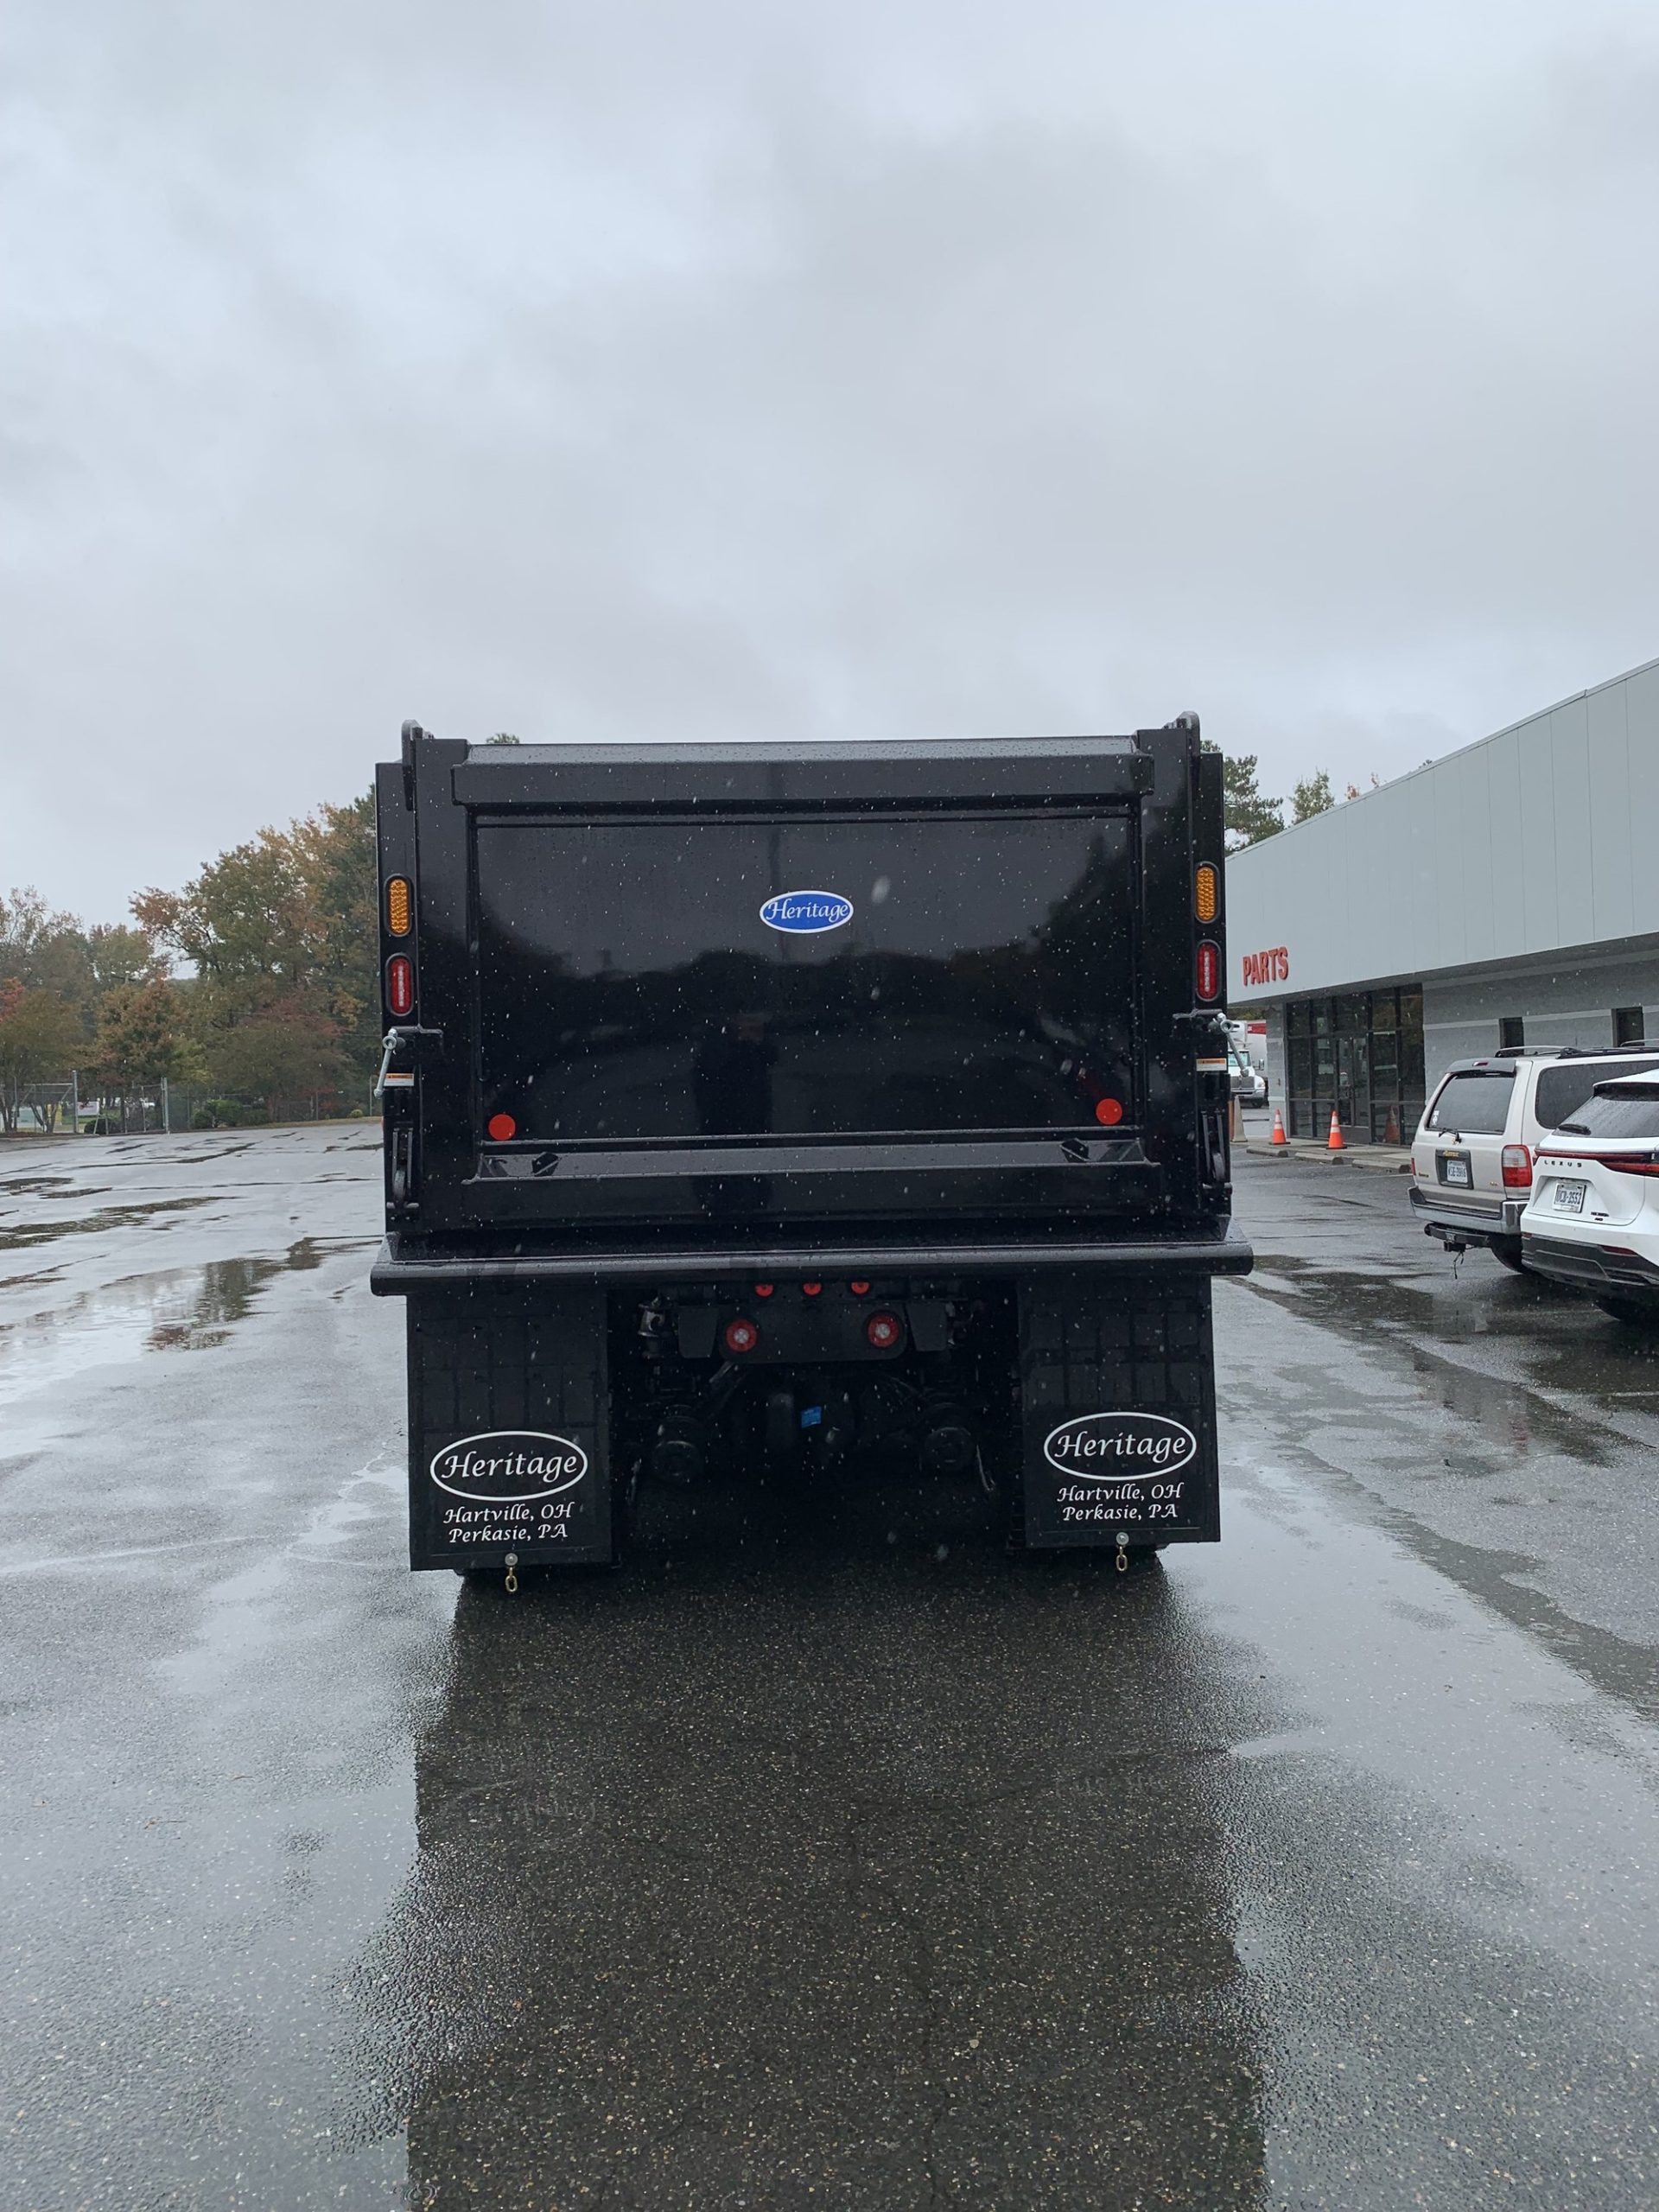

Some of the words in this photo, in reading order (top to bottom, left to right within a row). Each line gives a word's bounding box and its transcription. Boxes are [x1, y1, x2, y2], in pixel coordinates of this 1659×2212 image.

[766, 898, 849, 923] Heritage
[1243, 945, 1289, 987] PARTS
[1054, 1431, 1186, 1463] Heritage
[442, 1451, 577, 1483] Heritage
[1057, 1483, 1145, 1502] Hartville,
[1151, 1482, 1185, 1499] OH
[443, 1503, 535, 1523] Hartville,
[541, 1502, 575, 1519] OH
[1062, 1504, 1142, 1521] Perkasie,
[1148, 1503, 1178, 1518] PA
[448, 1525, 532, 1543] Perkasie,
[537, 1523, 569, 1539] PA
